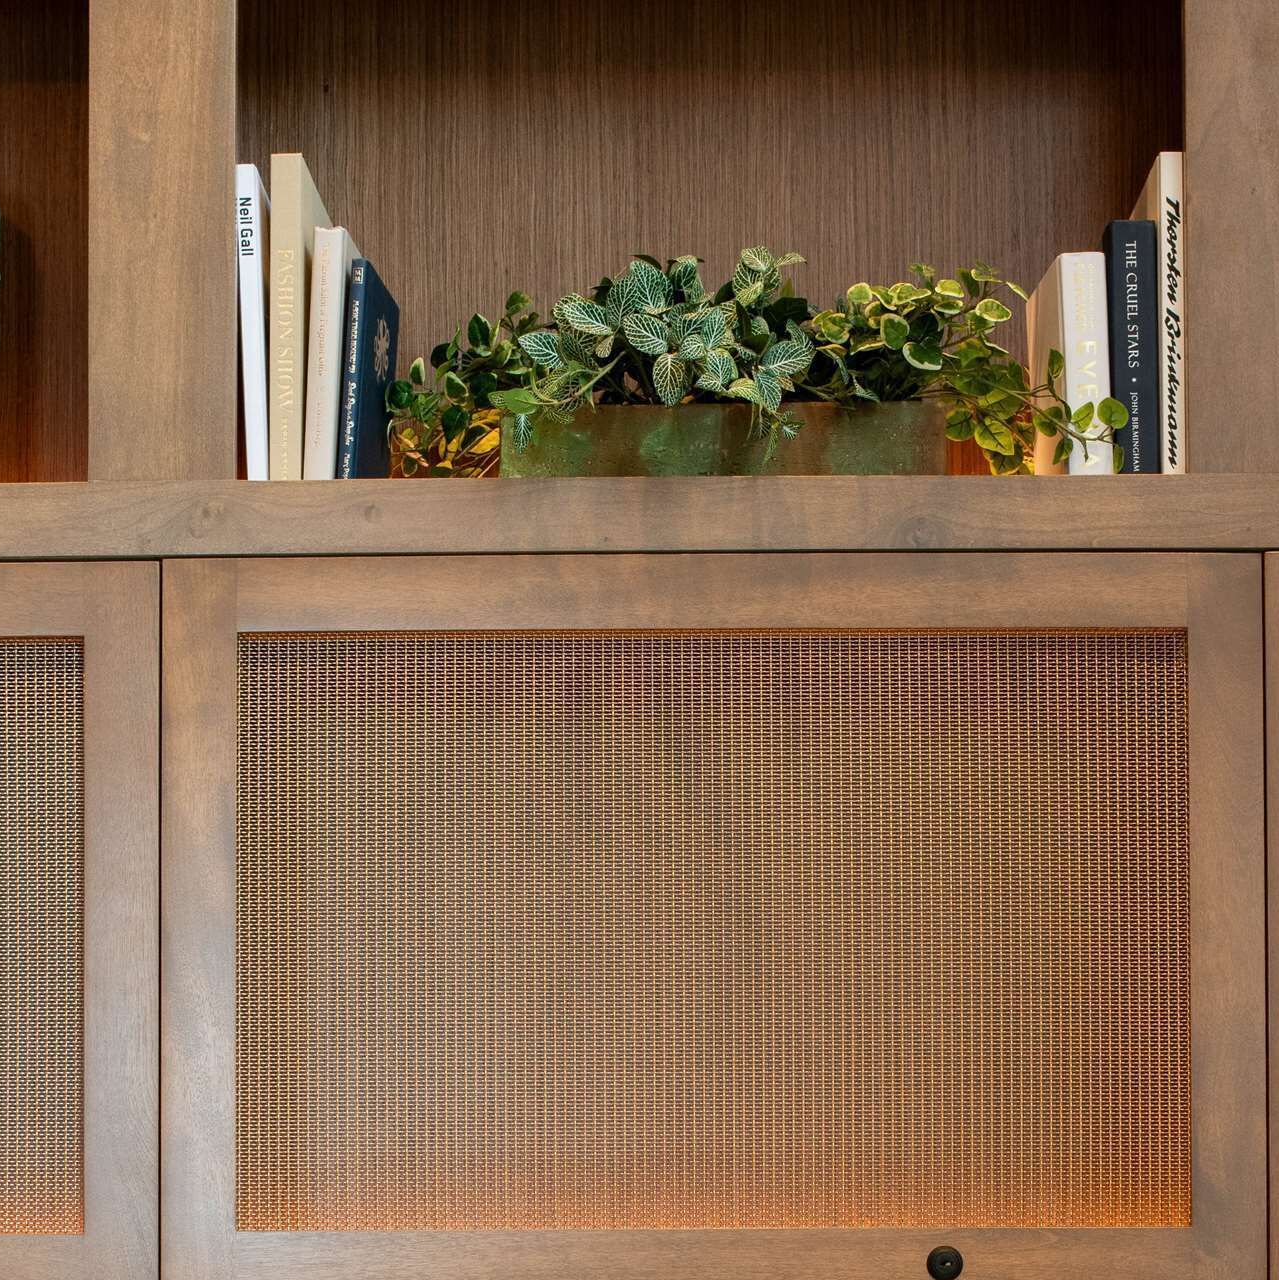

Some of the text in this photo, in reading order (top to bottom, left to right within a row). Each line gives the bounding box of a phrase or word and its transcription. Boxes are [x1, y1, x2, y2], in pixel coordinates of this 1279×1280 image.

[239, 197, 254, 256] Neil Gall
[277, 248, 295, 414] FASHION SHOW
[1125, 240, 1140, 369] THE CRUEL STARS
[1164, 196, 1182, 470] Thorsten Brinkmann
[1129, 391, 1140, 472] JOHN BIRMINGHAM
